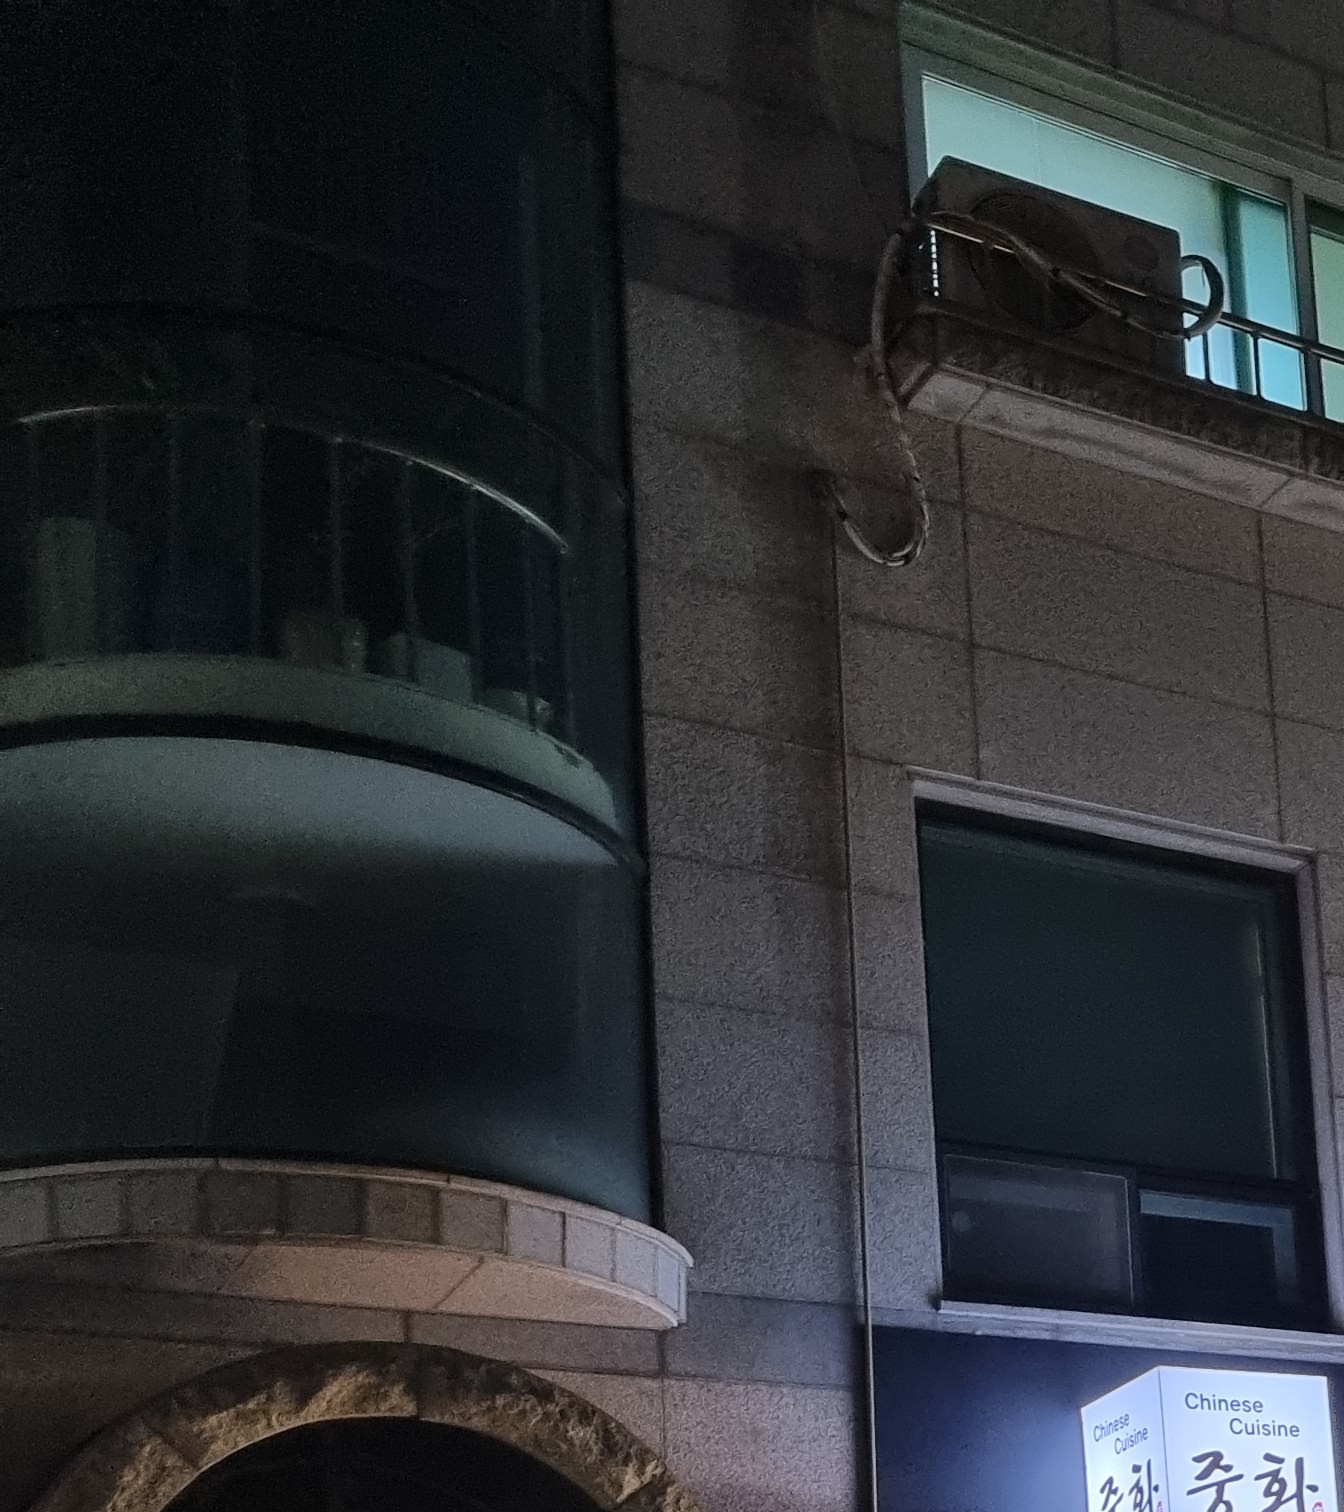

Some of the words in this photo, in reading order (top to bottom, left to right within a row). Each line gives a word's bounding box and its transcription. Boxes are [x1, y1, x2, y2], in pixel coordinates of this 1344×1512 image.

[1184, 1393, 1264, 1414] Chinese
[1093, 1412, 1130, 1443] Chinese
[1229, 1418, 1300, 1438] Cuisine
[1114, 1426, 1149, 1455] Cuisine
